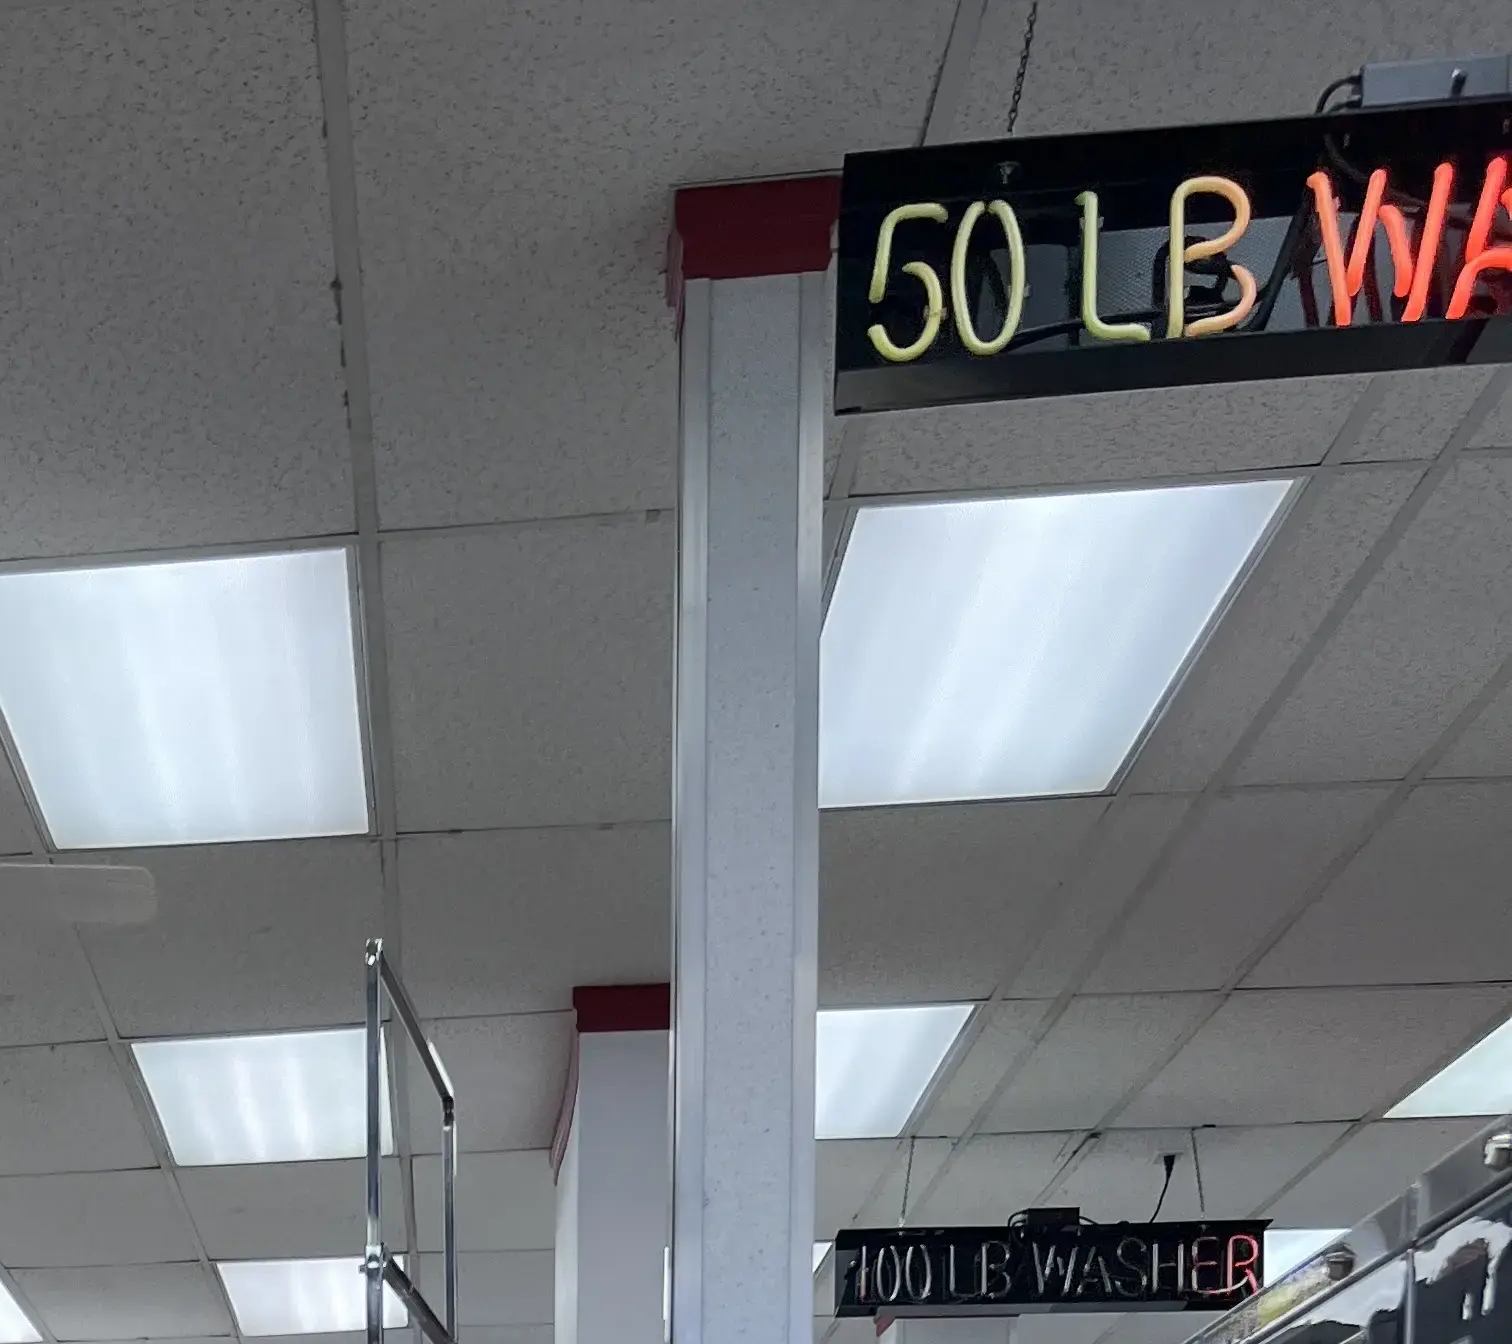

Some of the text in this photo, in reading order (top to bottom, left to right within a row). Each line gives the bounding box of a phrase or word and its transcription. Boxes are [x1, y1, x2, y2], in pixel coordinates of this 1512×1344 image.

[866, 199, 1026, 362] 50
[1074, 175, 1258, 342] LB
[849, 1234, 1260, 1303] 100 LB WASHER
